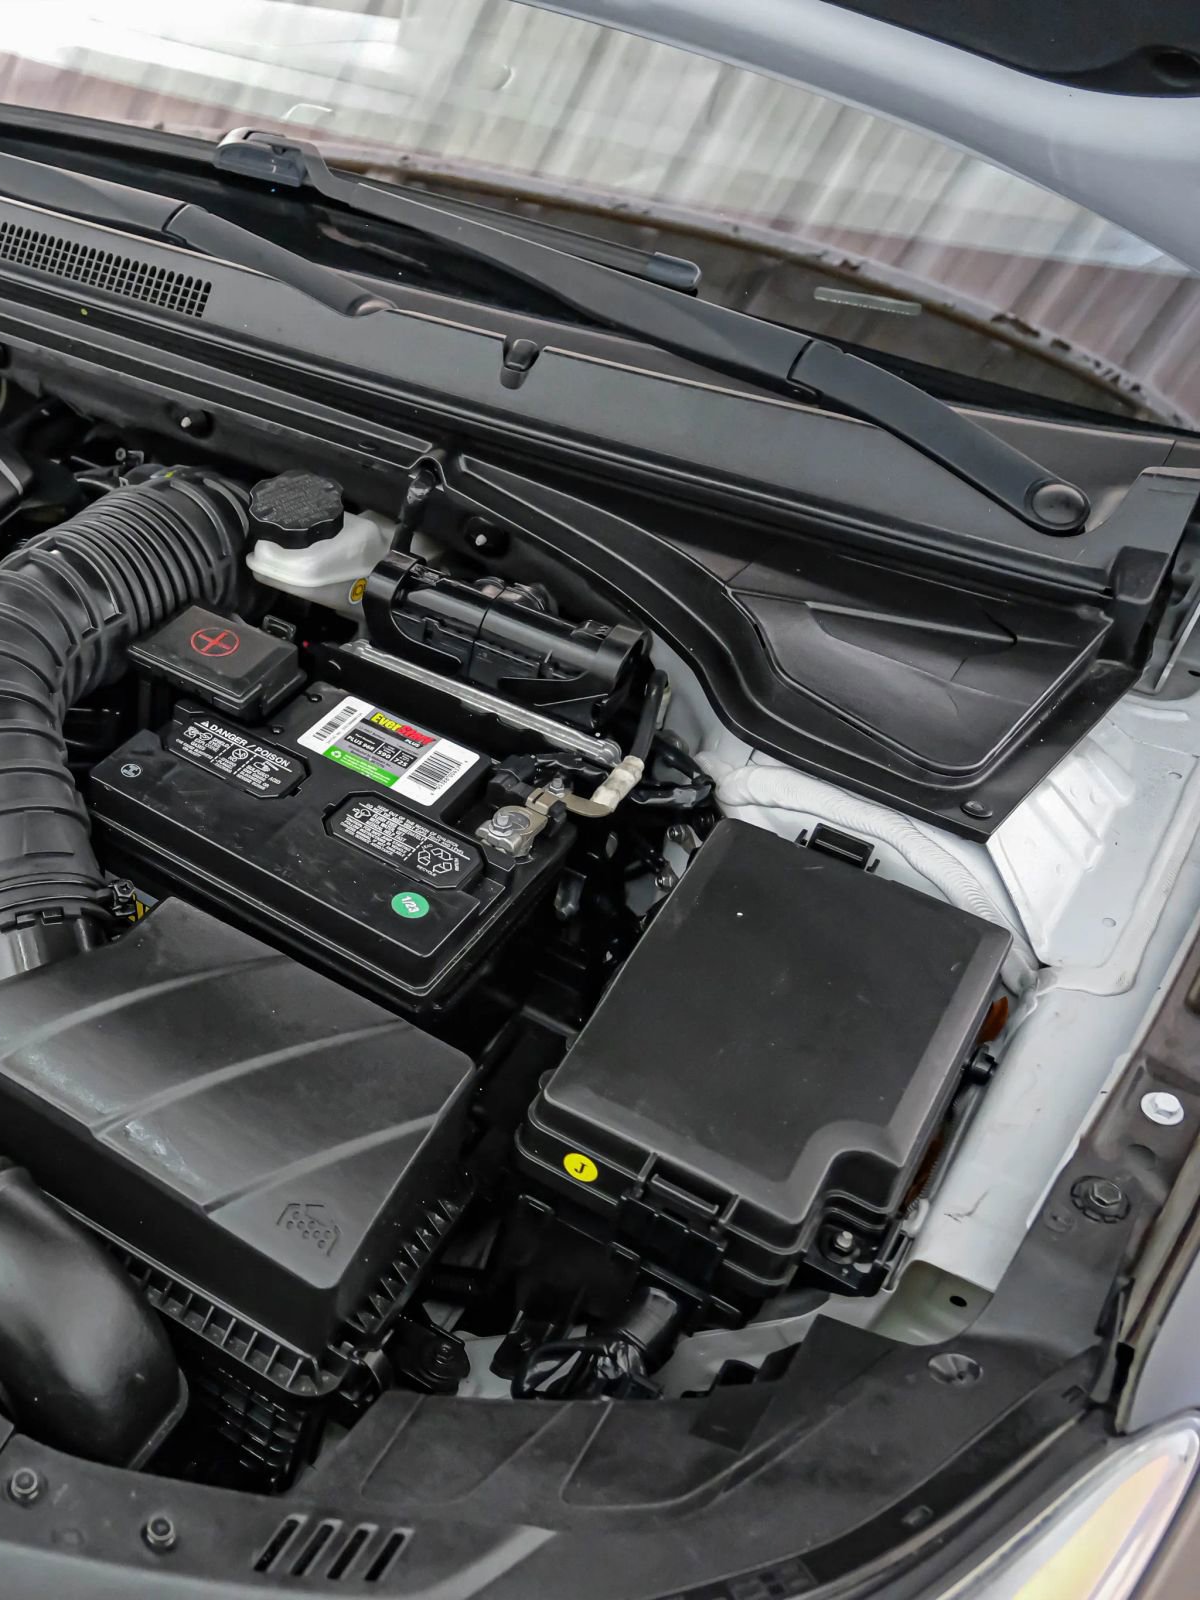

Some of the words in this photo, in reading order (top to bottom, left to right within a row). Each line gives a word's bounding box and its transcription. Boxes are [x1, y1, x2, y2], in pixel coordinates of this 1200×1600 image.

[370, 712, 435, 746] EverStart
[210, 724, 248, 746] DANGER
[254, 746, 290, 768] POISON
[346, 736, 363, 746] PLUS
[404, 738, 420, 748] PLUS
[377, 750, 392, 759] 590
[393, 758, 409, 768] 725
[402, 896, 420, 912] 1/23
[574, 1162, 587, 1174] J
